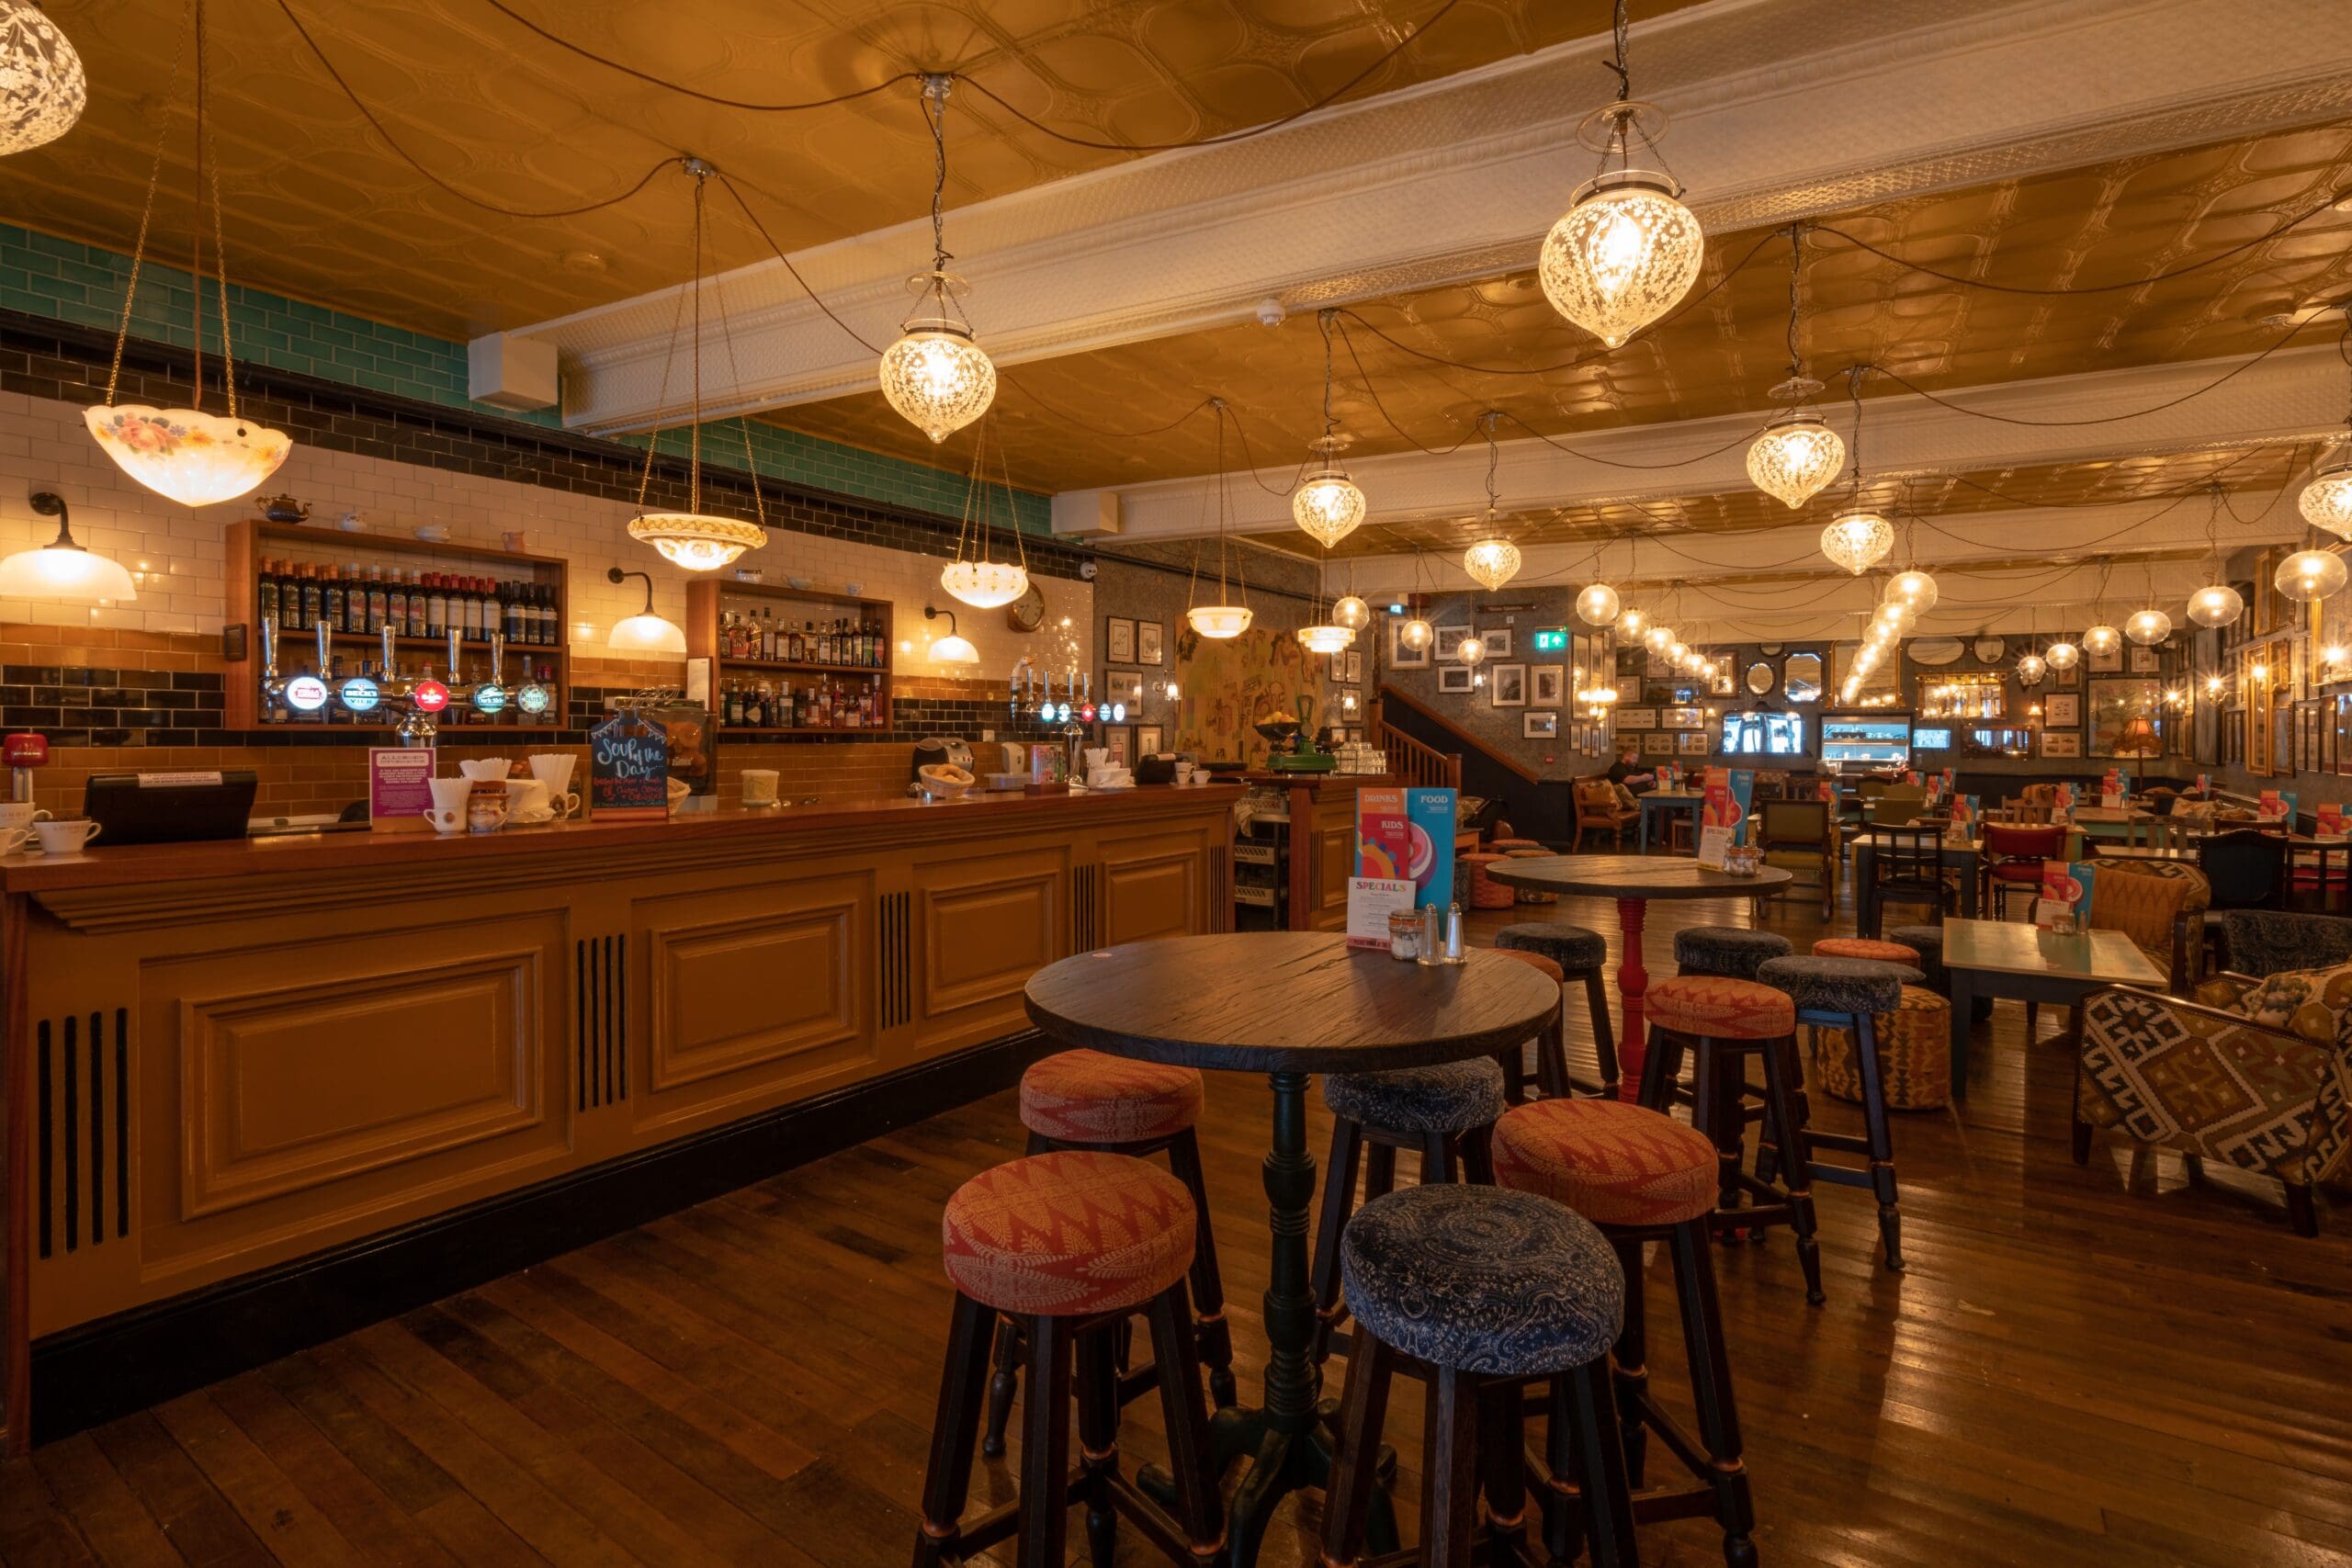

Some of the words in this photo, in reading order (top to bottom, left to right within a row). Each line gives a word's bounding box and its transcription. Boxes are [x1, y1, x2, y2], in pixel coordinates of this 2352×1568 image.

[597, 738, 637, 765] Soup
[644, 748, 662, 762] the
[1364, 794, 1397, 803] DRINKS
[1420, 795, 1448, 804] FOOD
[1381, 820, 1404, 829] KIDS
[1356, 881, 1407, 892] SPECIALS
